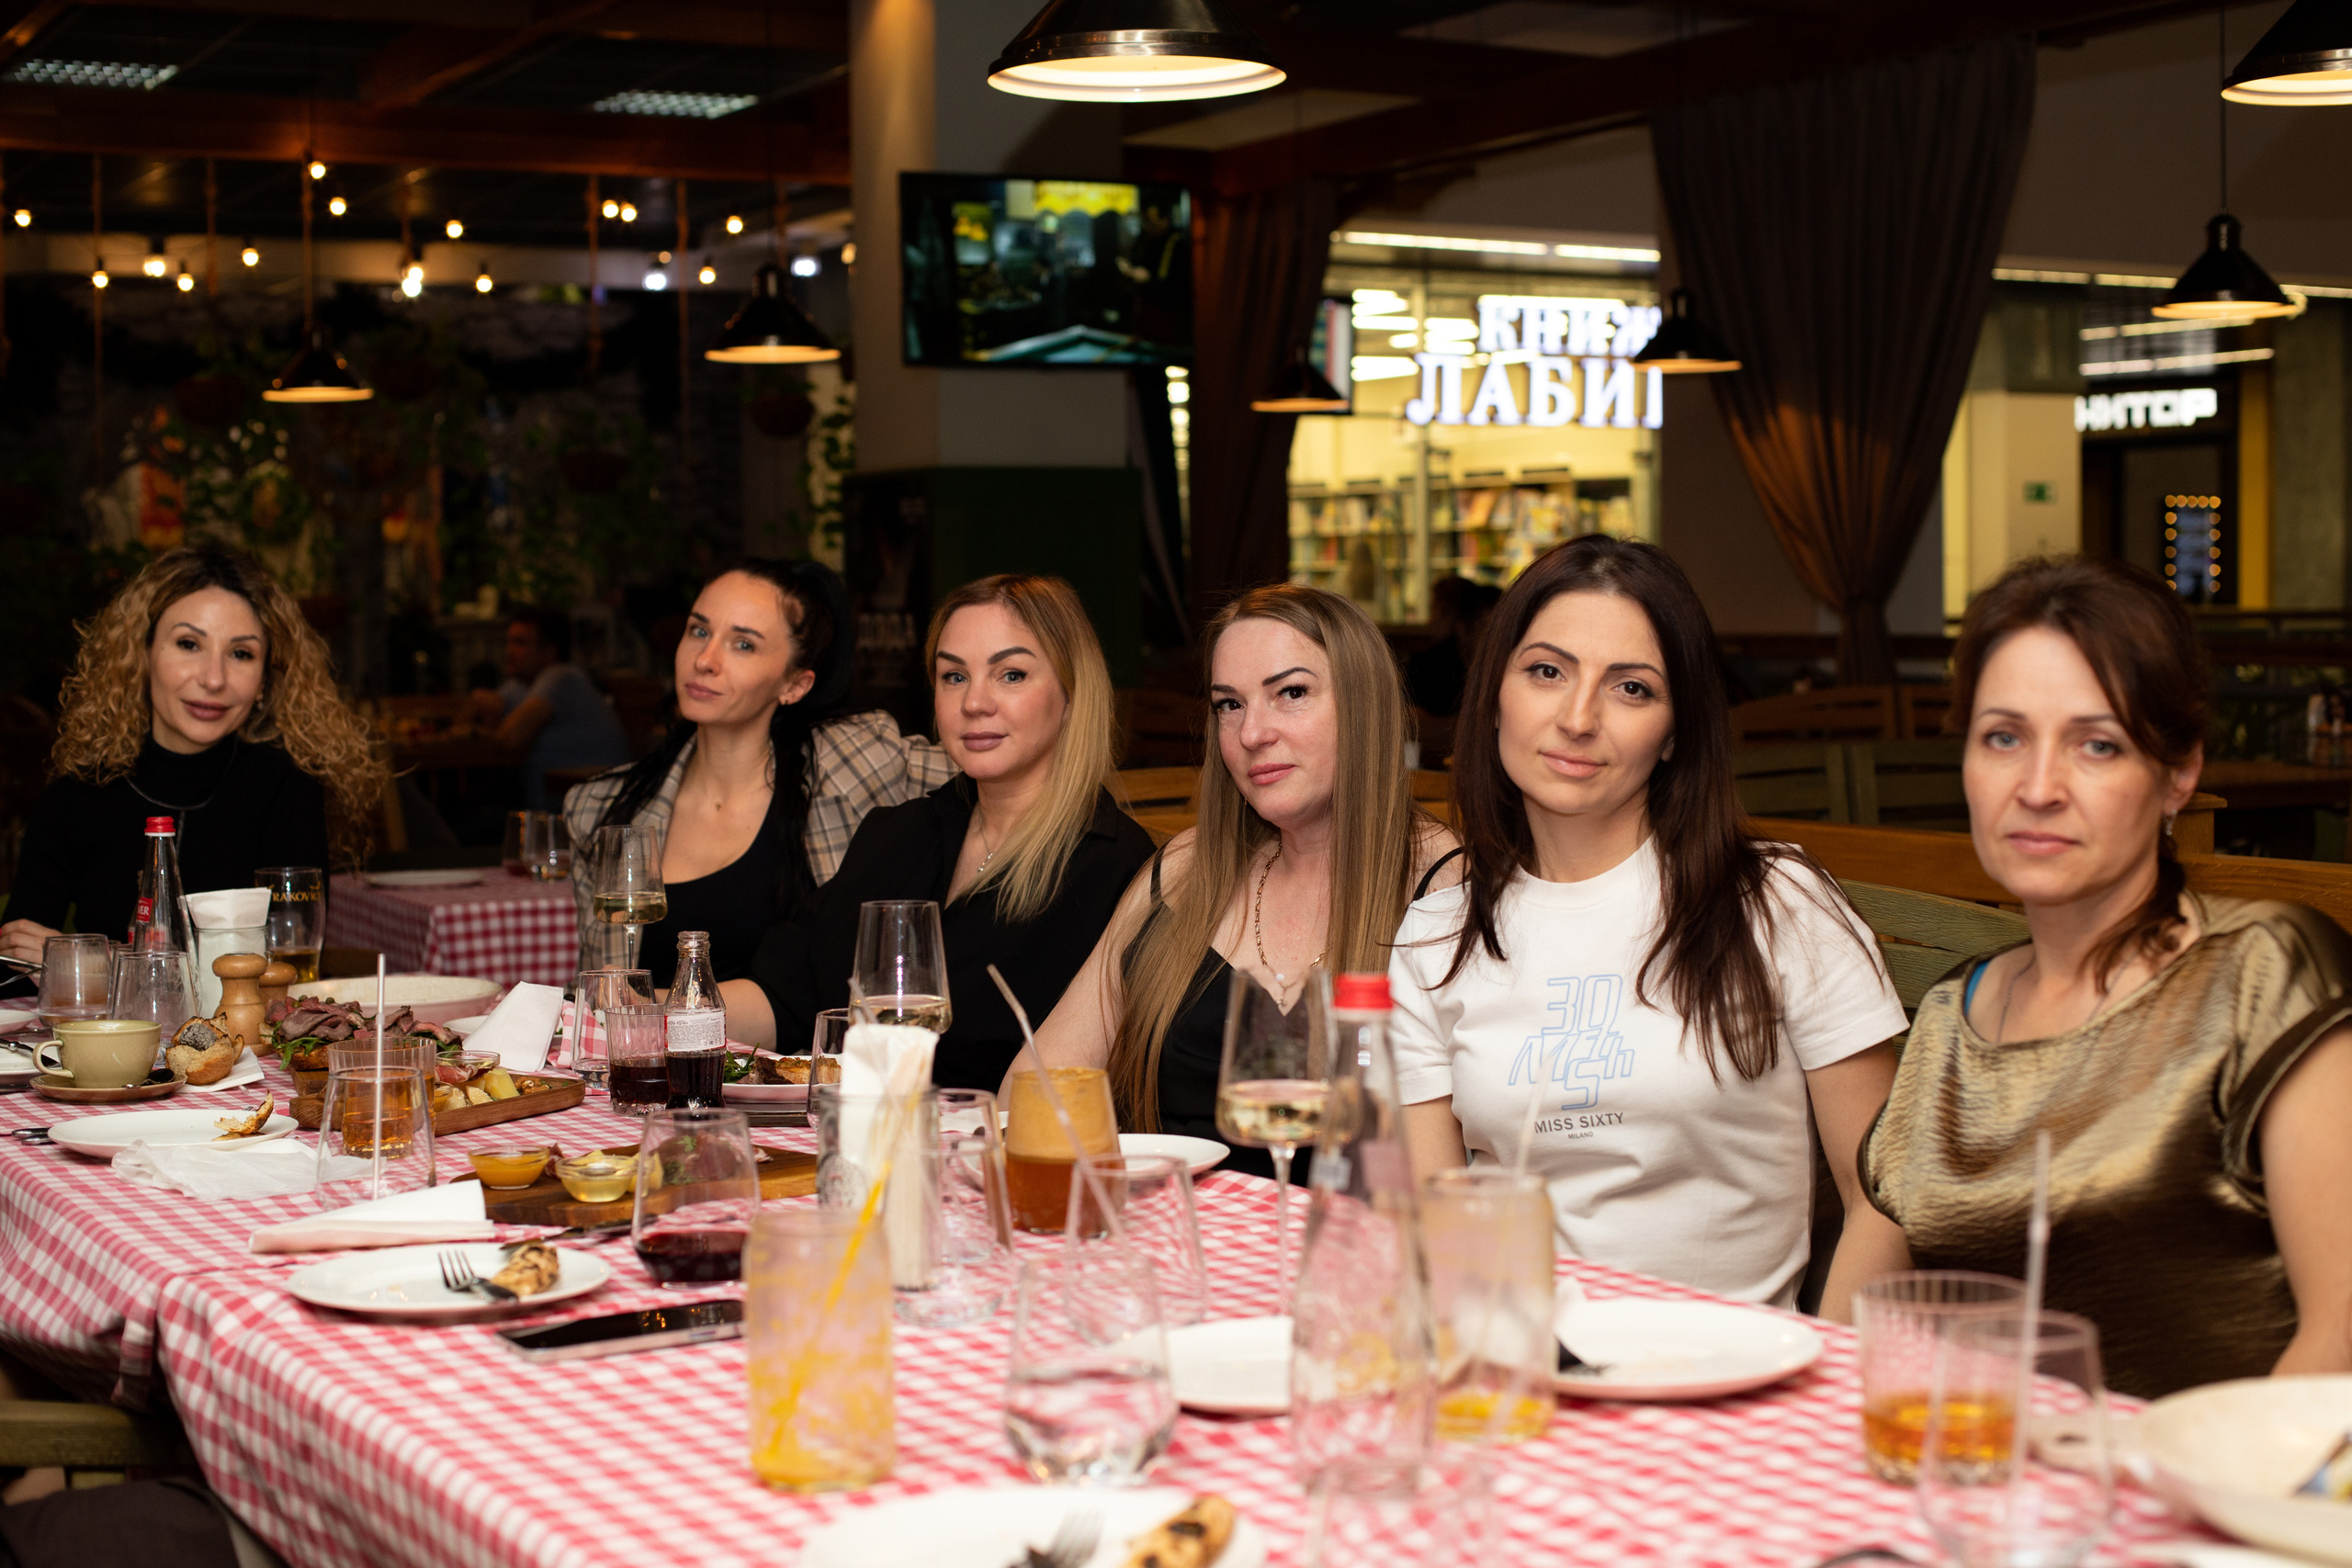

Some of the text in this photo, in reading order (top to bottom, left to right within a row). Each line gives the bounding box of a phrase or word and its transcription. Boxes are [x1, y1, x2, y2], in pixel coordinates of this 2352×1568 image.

[1542, 975, 1623, 1034] 30
[1533, 1112, 1624, 1134] MISS SIXTY
[1567, 1131, 1594, 1140] MILANO
